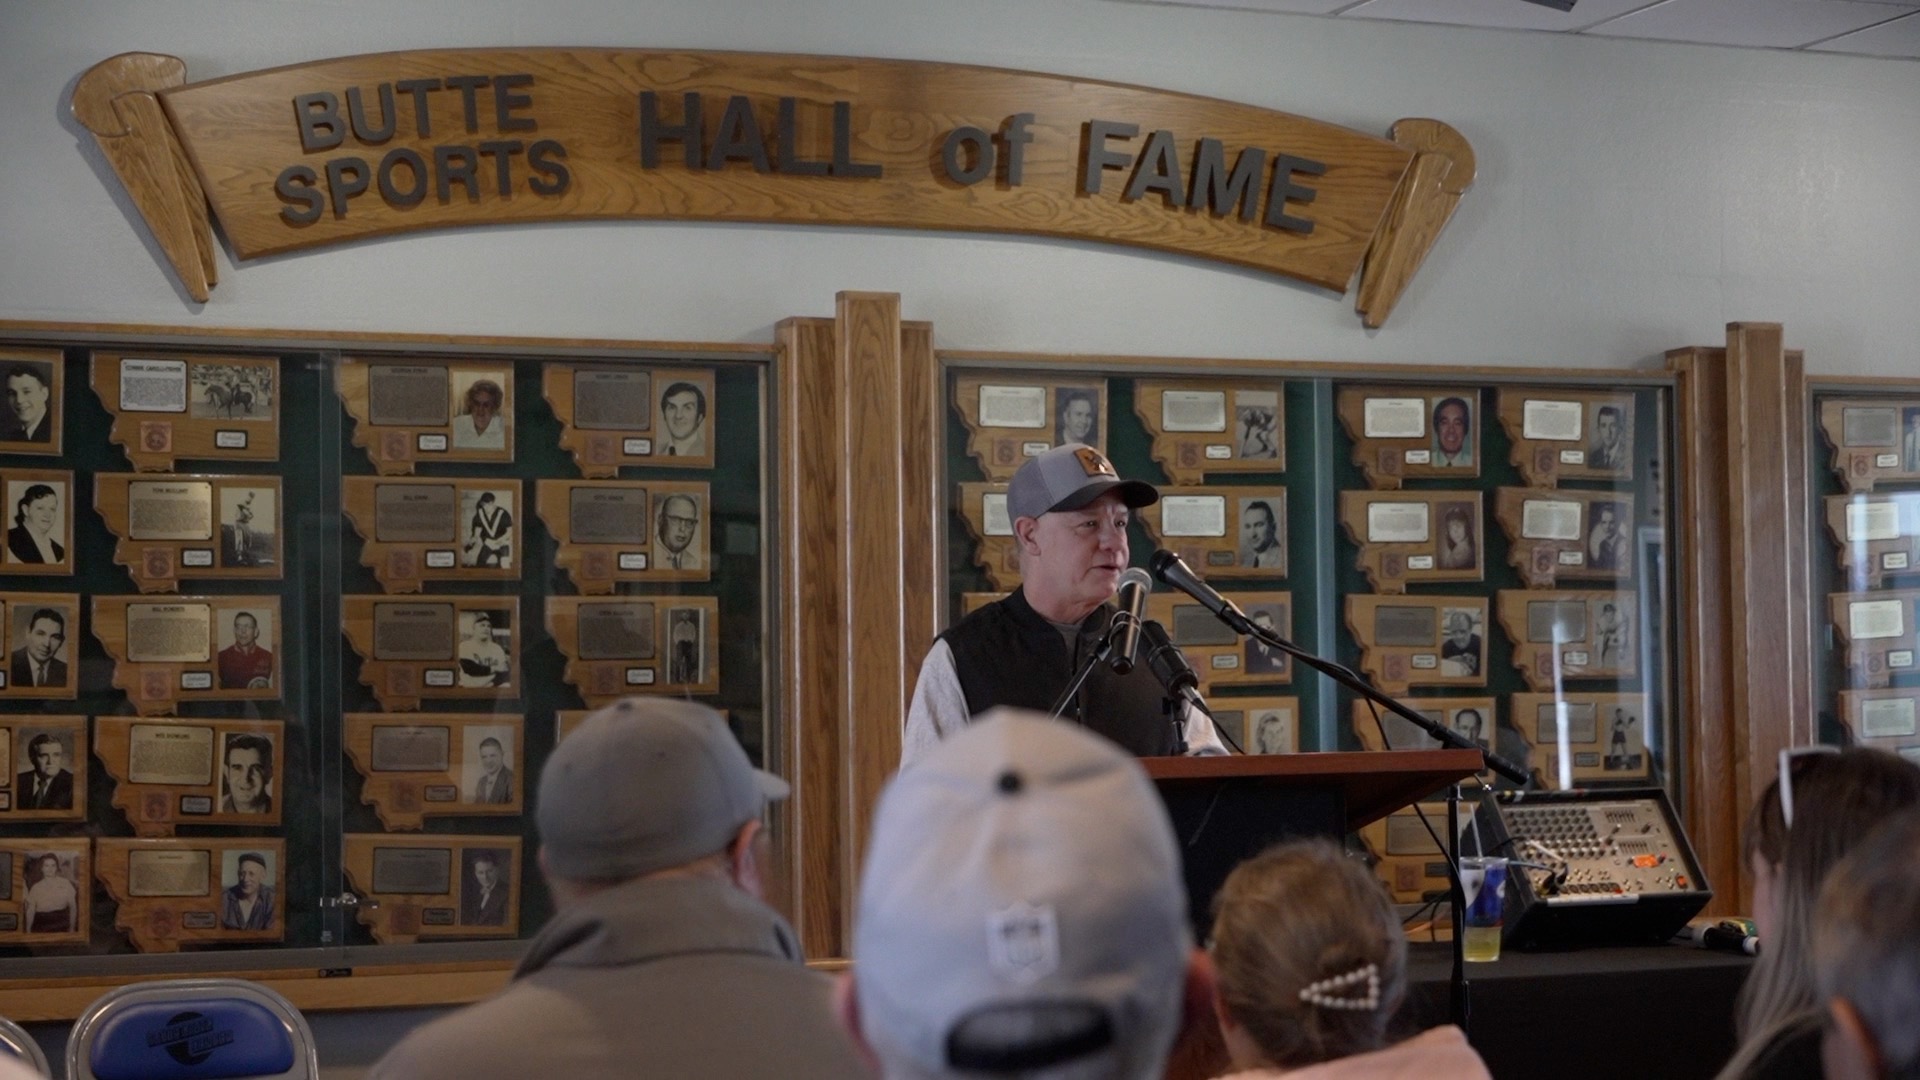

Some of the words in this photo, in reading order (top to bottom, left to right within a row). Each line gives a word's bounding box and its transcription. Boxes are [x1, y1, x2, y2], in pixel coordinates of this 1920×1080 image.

[294, 74, 537, 153] BUTTE
[275, 139, 570, 227] SPORTS
[640, 91, 882, 178] HALL
[940, 112, 1034, 187] of
[1083, 119, 1326, 234] FAME
